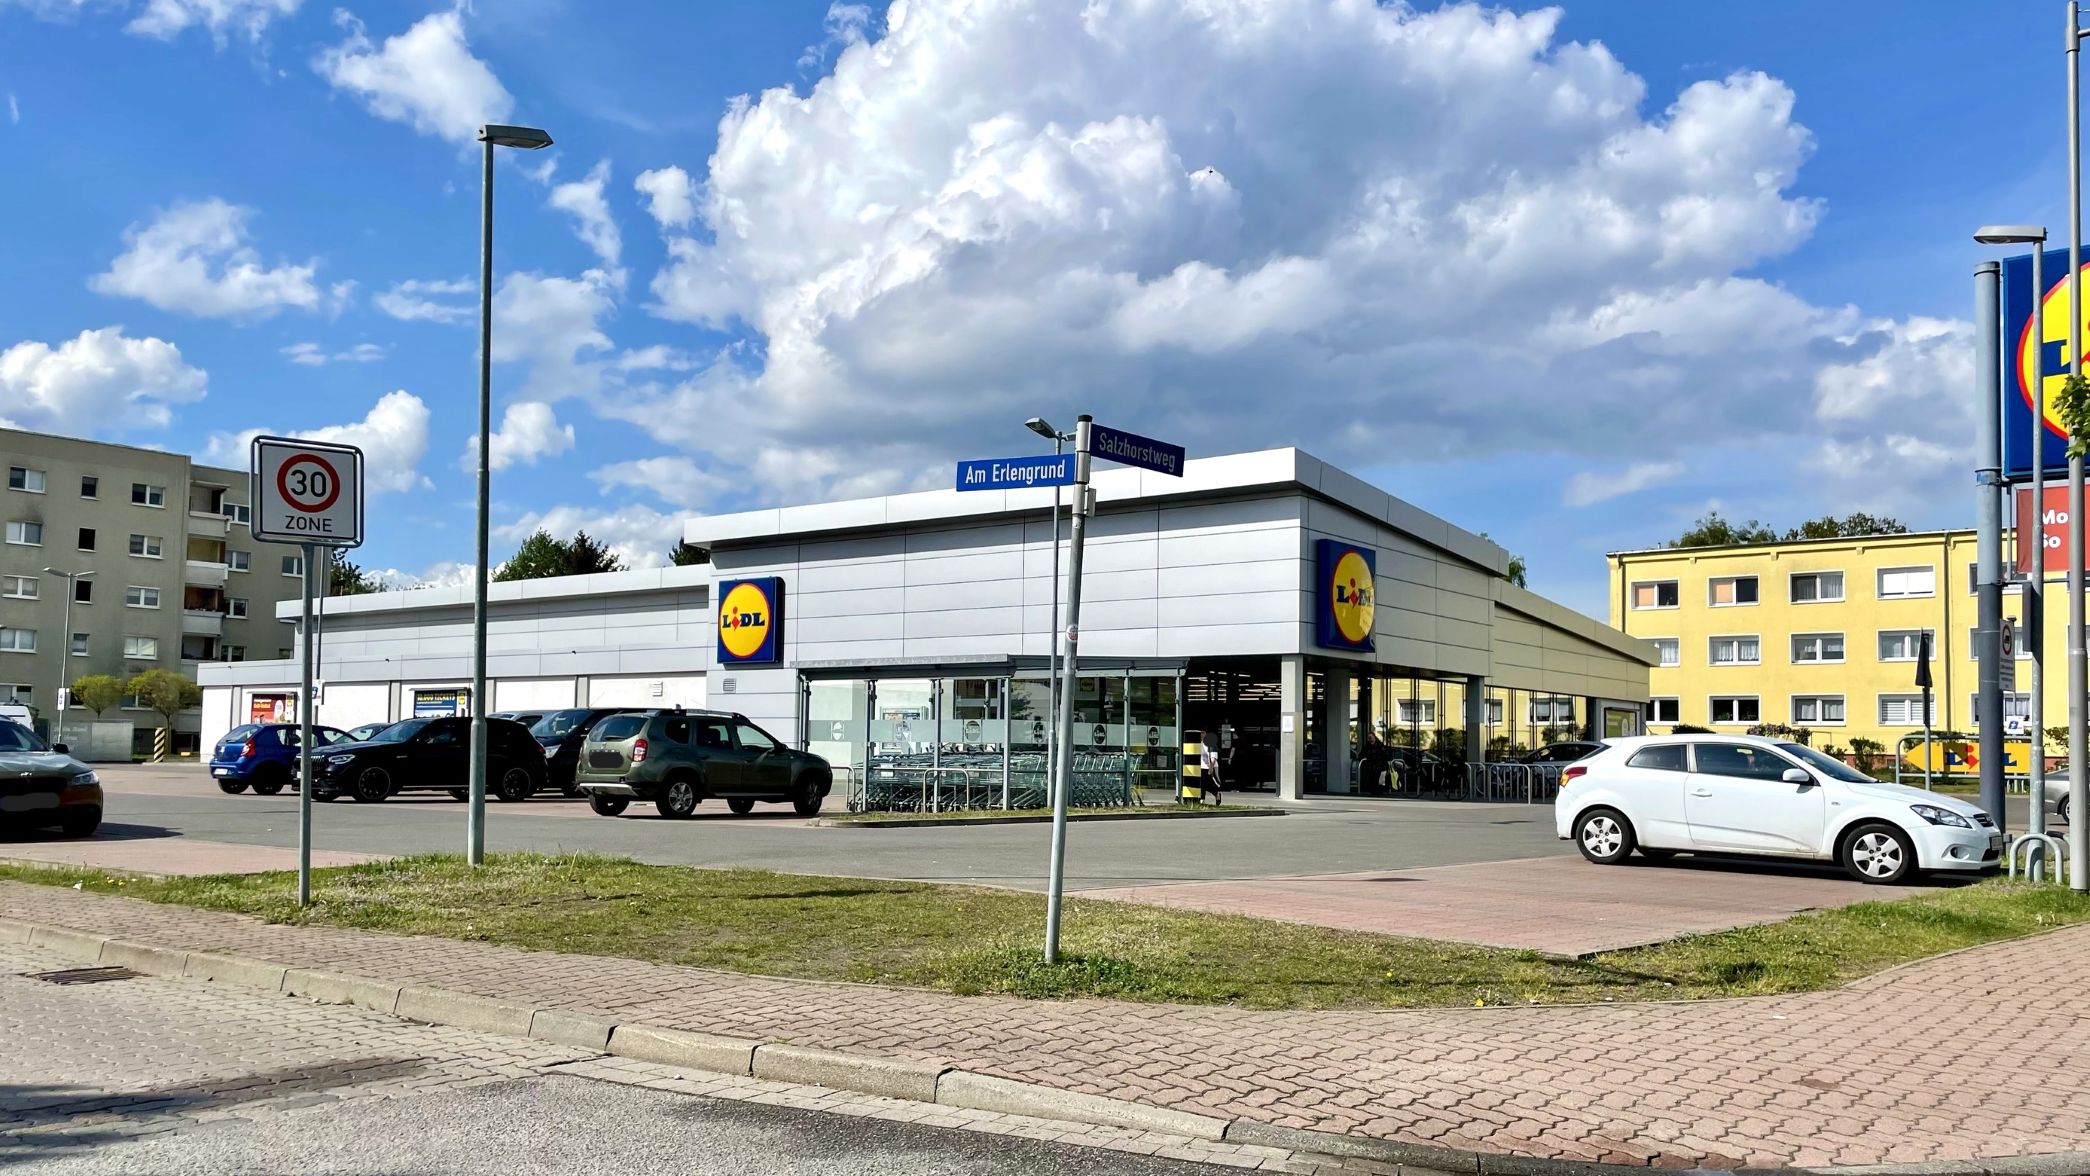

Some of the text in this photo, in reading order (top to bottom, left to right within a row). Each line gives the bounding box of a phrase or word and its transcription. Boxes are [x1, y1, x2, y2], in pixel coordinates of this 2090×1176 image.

[1099, 433, 1175, 472] Salzhorstweg
[291, 469, 326, 497] 30
[965, 459, 1065, 485] Am Erlengrund
[285, 515, 332, 532] ZONE
